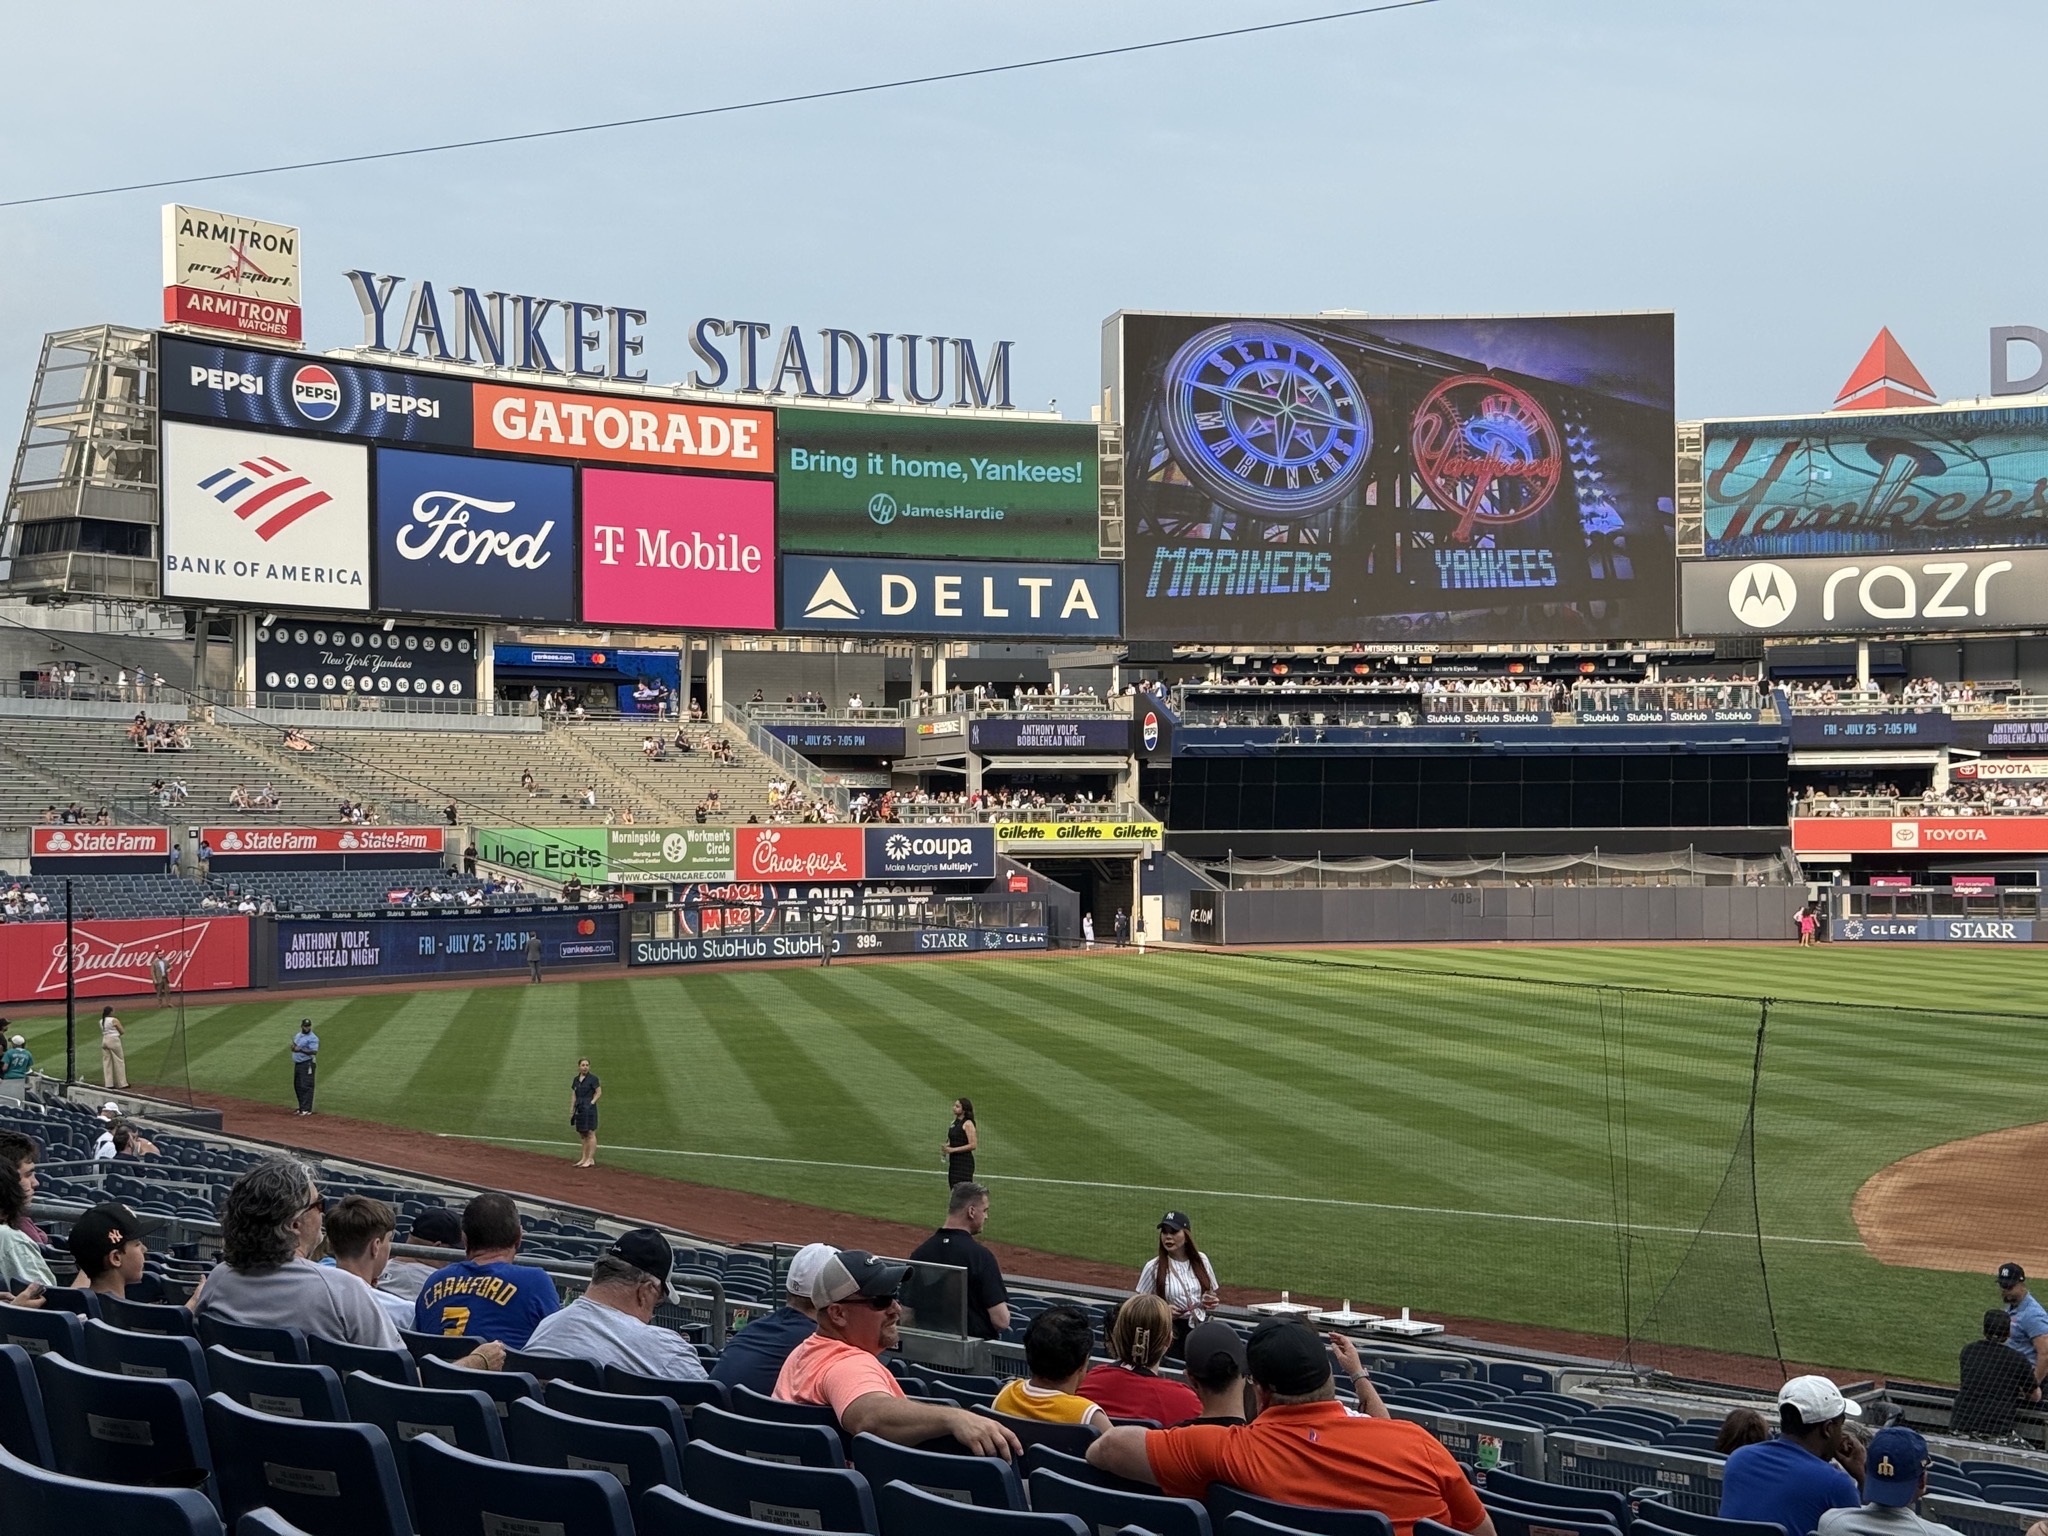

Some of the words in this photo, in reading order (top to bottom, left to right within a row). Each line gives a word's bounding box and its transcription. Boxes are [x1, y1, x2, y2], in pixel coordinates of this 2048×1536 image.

[180, 219, 293, 255] ARMITRON
[187, 294, 289, 324] ARMITRON
[238, 318, 288, 334] WATCHES
[342, 269, 648, 384] YANKEE
[688, 316, 1016, 411] STADIUM
[191, 365, 263, 395] PEPSI
[1209, 339, 1353, 408] SEATTLE
[295, 384, 338, 401] PEPSI
[370, 392, 440, 418] PEPSI
[492, 397, 759, 459] GATORADE
[1194, 410, 1353, 489] MARINERS
[791, 447, 857, 479] Bring
[867, 453, 884, 475] it
[891, 454, 968, 483] home,
[970, 457, 1083, 484] Yankees!
[902, 503, 1005, 520] JamesHardie
[396, 490, 556, 571] Ford
[635, 528, 762, 574] Mobile
[167, 554, 226, 577] BANK
[233, 561, 260, 579] OF
[266, 563, 363, 586] AMERICA
[1146, 546, 1332, 598] MARINERS
[1434, 549, 1558, 589] YANKEES
[881, 574, 1100, 620] DELTA
[1823, 560, 2012, 621] razr
[1364, 644, 1403, 652] MITSUBISHI
[319, 651, 344, 665] New
[343, 653, 370, 672] York
[371, 654, 412, 673] Yankees
[1427, 714, 1460, 724] StubHub
[1464, 714, 1499, 723] StubHub
[1503, 713, 1539, 723] StubHub
[1583, 713, 1619, 722] StubHub
[1627, 712, 1663, 722] StubHub
[1670, 712, 1707, 721] StubHub
[1714, 711, 1752, 721] StubHub
[1021, 725, 1054, 735] ANTHONY
[1057, 724, 1079, 735] VOLPE
[1144, 728, 1157, 736] PEPSI
[1823, 724, 1837, 736] FRI
[1844, 724, 1864, 735] JULY
[1865, 723, 1877, 735] 25
[1884, 723, 1901, 735] 7:05
[1903, 723, 1917, 734] PM
[1993, 723, 2028, 734] ANTHONY
[787, 735, 799, 746] FRI
[804, 735, 821, 746] JULY
[822, 735, 832, 746] 25
[838, 735, 853, 746] 7:05
[854, 735, 865, 746] PM
[1017, 735, 1063, 746] BOBBLEHEAD
[1064, 735, 1086, 746] NIGHT
[1988, 734, 2037, 744] BOBBLEHEAD
[1980, 764, 2032, 774] TOYOTA
[612, 831, 661, 846] Morningside
[687, 829, 731, 842] Workmen's
[999, 825, 1045, 839] Gillette
[1056, 825, 1102, 839] Gillette
[1113, 824, 1157, 838] Gillette
[1924, 830, 1987, 840] TOYOTA
[483, 845, 539, 868] Uber
[545, 844, 602, 868] Eats
[706, 842, 730, 855] Circle
[752, 840, 848, 876] Chick-fil-A
[912, 837, 972, 860] coupa
[885, 863, 905, 872] Make
[907, 863, 938, 874] Margins
[1451, 892, 1472, 904] 408
[1871, 926, 1916, 935] CLEAR
[1950, 922, 2017, 939] STARR
[292, 932, 338, 951] ANTHONY
[341, 931, 370, 949] VOLPE
[419, 936, 435, 955] FRI
[446, 934, 470, 953] JULY
[472, 933, 485, 952] 25
[495, 932, 517, 951] 7:05
[562, 944, 612, 956] yankees.com
[638, 940, 697, 962] StubHub
[702, 938, 767, 958] StubHub
[773, 937, 840, 955] StubHb
[857, 934, 877, 948] 399
[921, 934, 969, 949] STARR
[1006, 933, 1044, 943] CLEAR
[285, 948, 348, 969] BOBBLEHEAD
[351, 948, 380, 966] NIGHT
[424, 1276, 518, 1309] CRAWFORD
